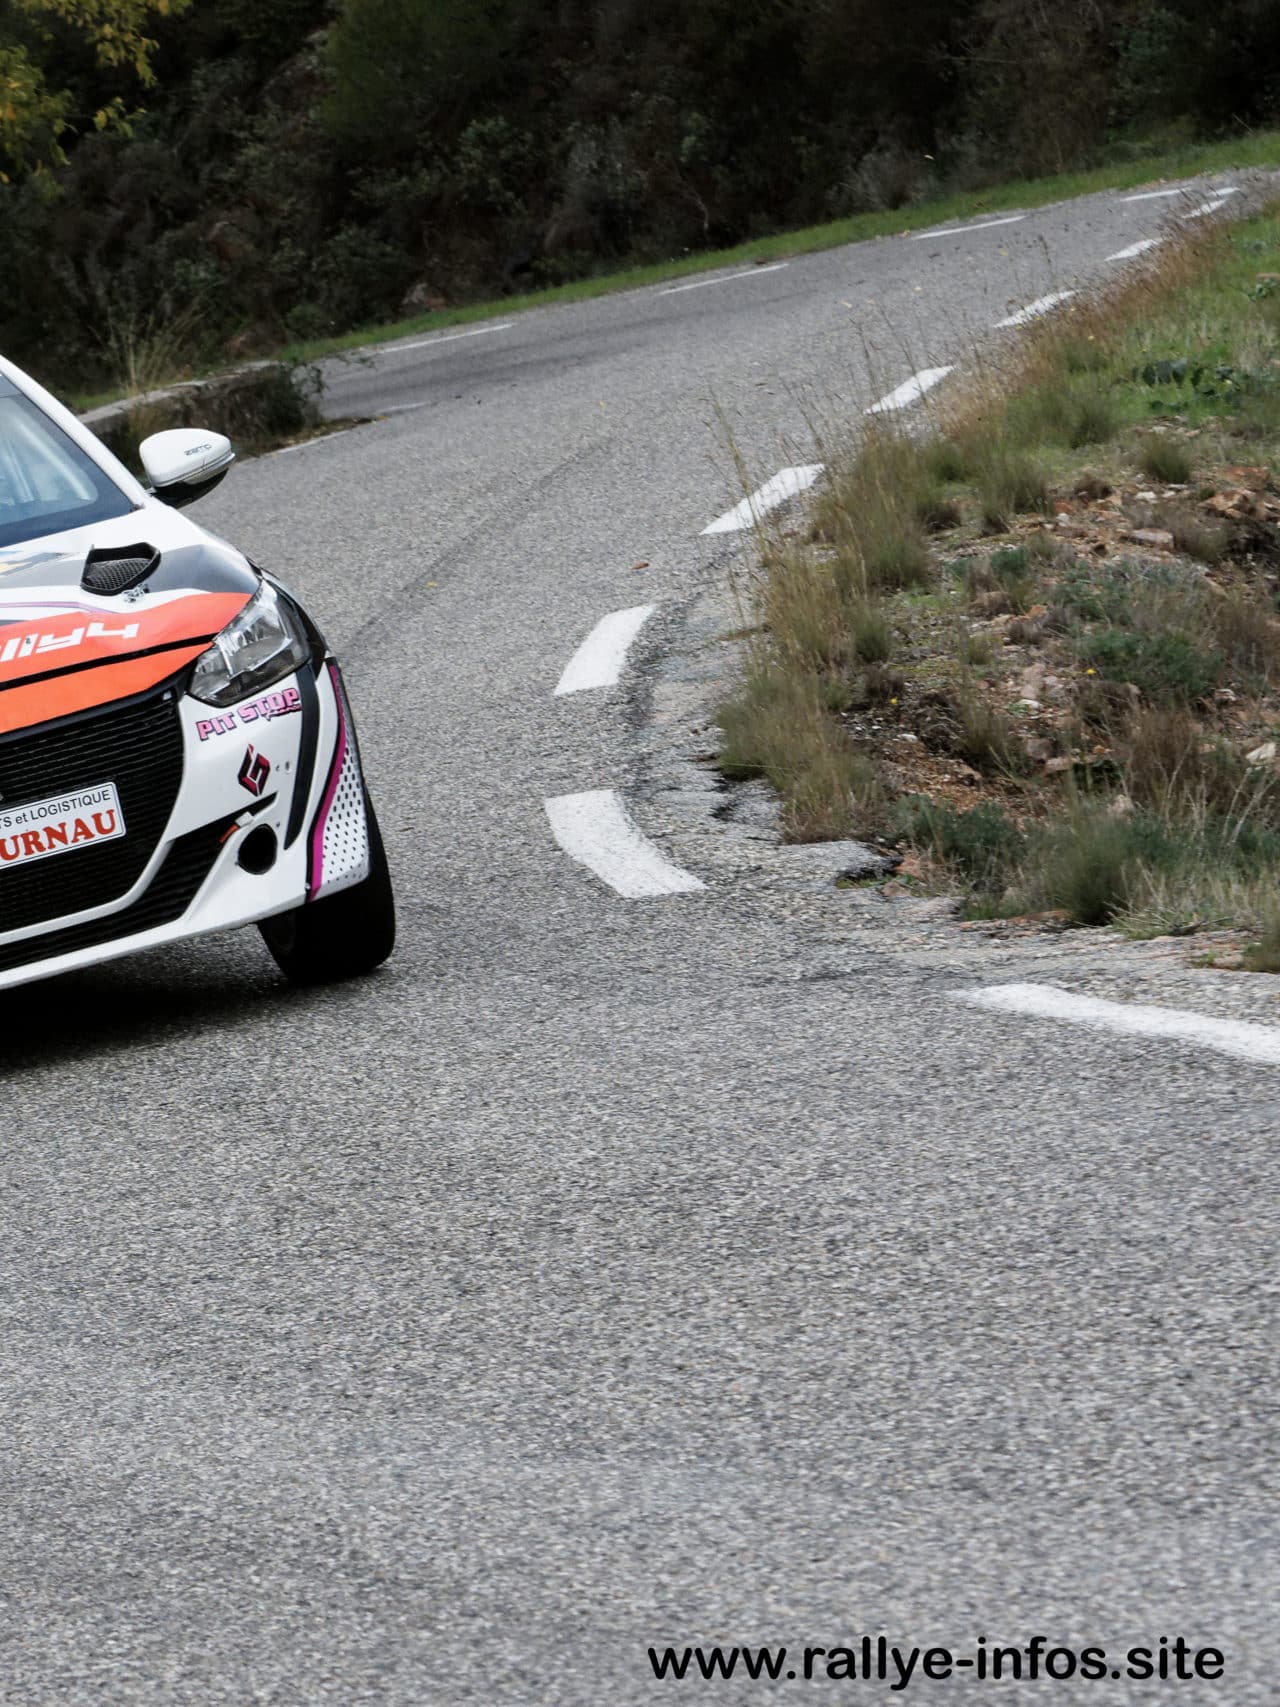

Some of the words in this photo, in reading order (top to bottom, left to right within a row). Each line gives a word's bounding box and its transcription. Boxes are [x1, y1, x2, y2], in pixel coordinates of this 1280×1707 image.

[195, 712, 237, 742] PIT
[237, 688, 300, 723] STOP
[15, 812, 28, 824] et
[30, 789, 112, 821] LOGISTIQUE
